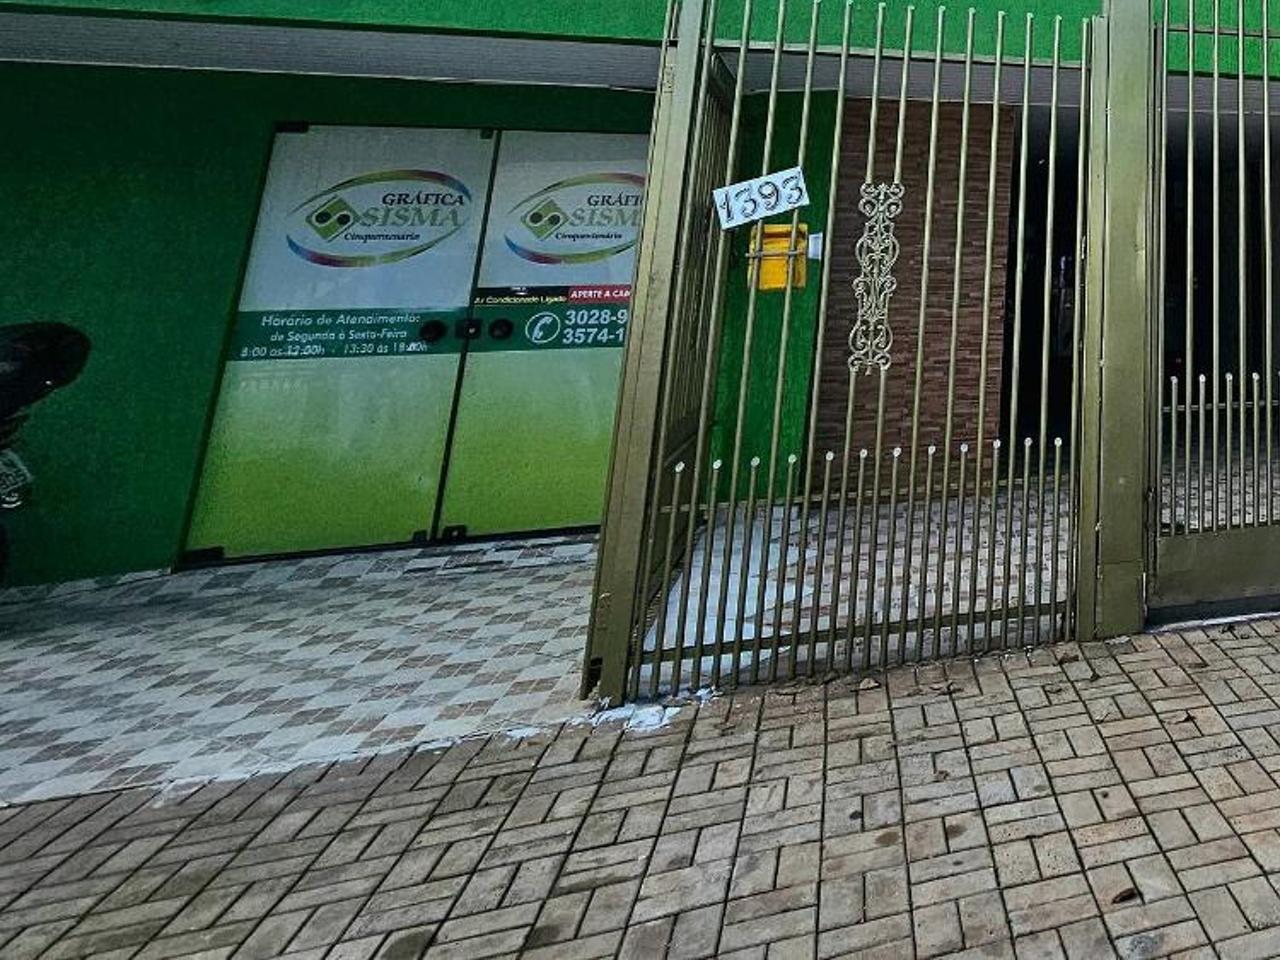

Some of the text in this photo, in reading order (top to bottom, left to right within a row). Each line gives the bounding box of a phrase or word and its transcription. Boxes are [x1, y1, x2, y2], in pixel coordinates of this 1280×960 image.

[382, 190, 464, 207] GRÁFICA
[719, 175, 803, 222] 1393
[359, 206, 464, 227] SISMA
[570, 290, 602, 299] APERTE
[604, 290, 611, 298] A
